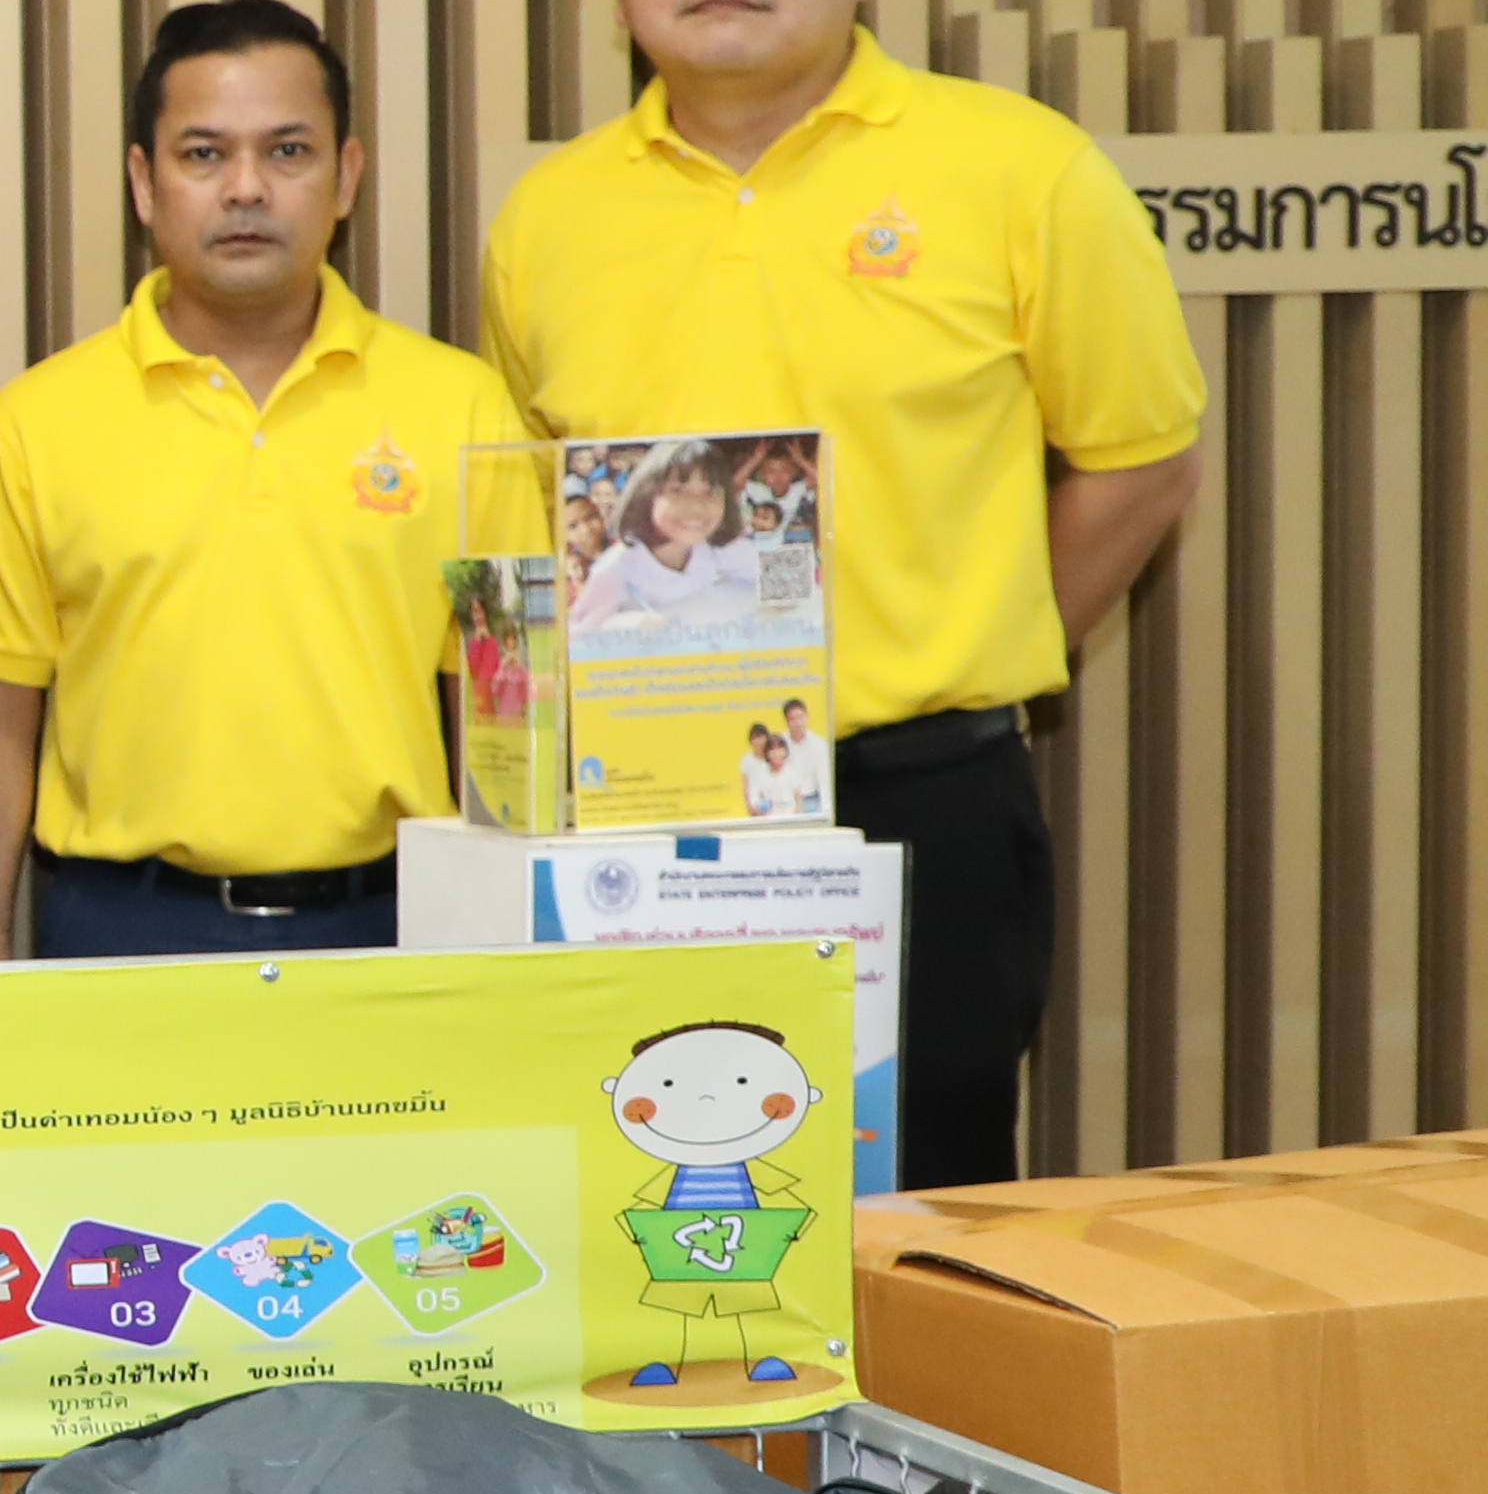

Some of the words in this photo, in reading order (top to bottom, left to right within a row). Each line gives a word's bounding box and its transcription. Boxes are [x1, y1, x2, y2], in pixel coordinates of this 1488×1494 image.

[230, 1090, 447, 1125] มูลนิธิบ้านนกขมิ้น
[256, 1294, 304, 1321] 04
[416, 1287, 461, 1313] 05
[110, 1301, 157, 1328] 03
[48, 1360, 209, 1387] เครื่องใช้ไฟฟ้า
[247, 1357, 335, 1380] ของเล่น
[408, 1347, 494, 1377] อุปกรณ์
[48, 1390, 129, 1415] ทุกชนิด
